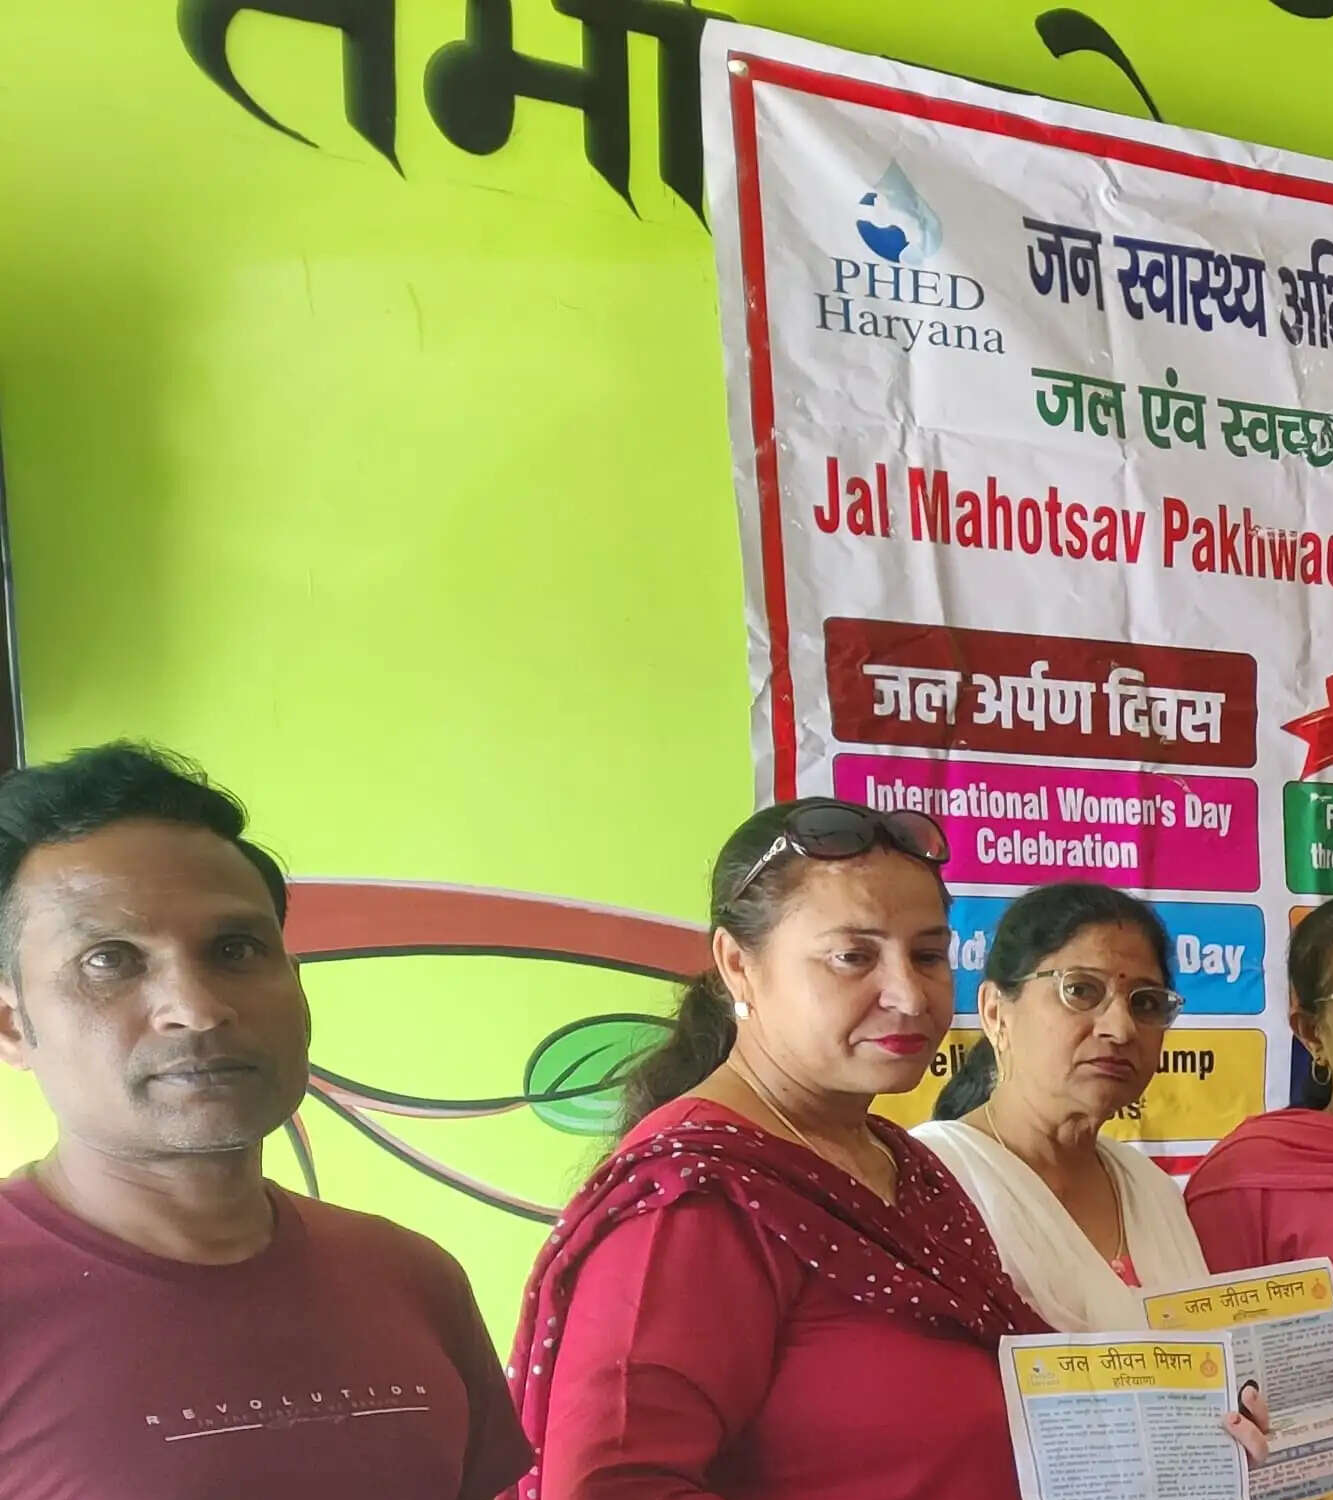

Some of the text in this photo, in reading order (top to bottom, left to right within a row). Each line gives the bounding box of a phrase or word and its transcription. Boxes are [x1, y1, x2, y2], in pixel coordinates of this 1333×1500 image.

[831, 255, 985, 312] PHED
[1022, 216, 1105, 312] जन
[1113, 235, 1268, 337] स्वास्थ्य
[813, 291, 1006, 353] Haryana
[1031, 367, 1126, 440] जल
[813, 456, 890, 538] Jal
[907, 465, 1146, 565] Mahotsav
[862, 660, 1226, 745] जल अर्पण दिवस
[866, 775, 1233, 838] International Women's Day
[976, 827, 1139, 870] Celebration
[1176, 933, 1247, 984] Day
[1157, 1050, 1215, 1080] ump
[1184, 1280, 1305, 1313] जल जीवन मिशन
[1057, 1346, 1193, 1373] जल जीवन मिशन
[145, 1384, 427, 1426] REVOLUTION
